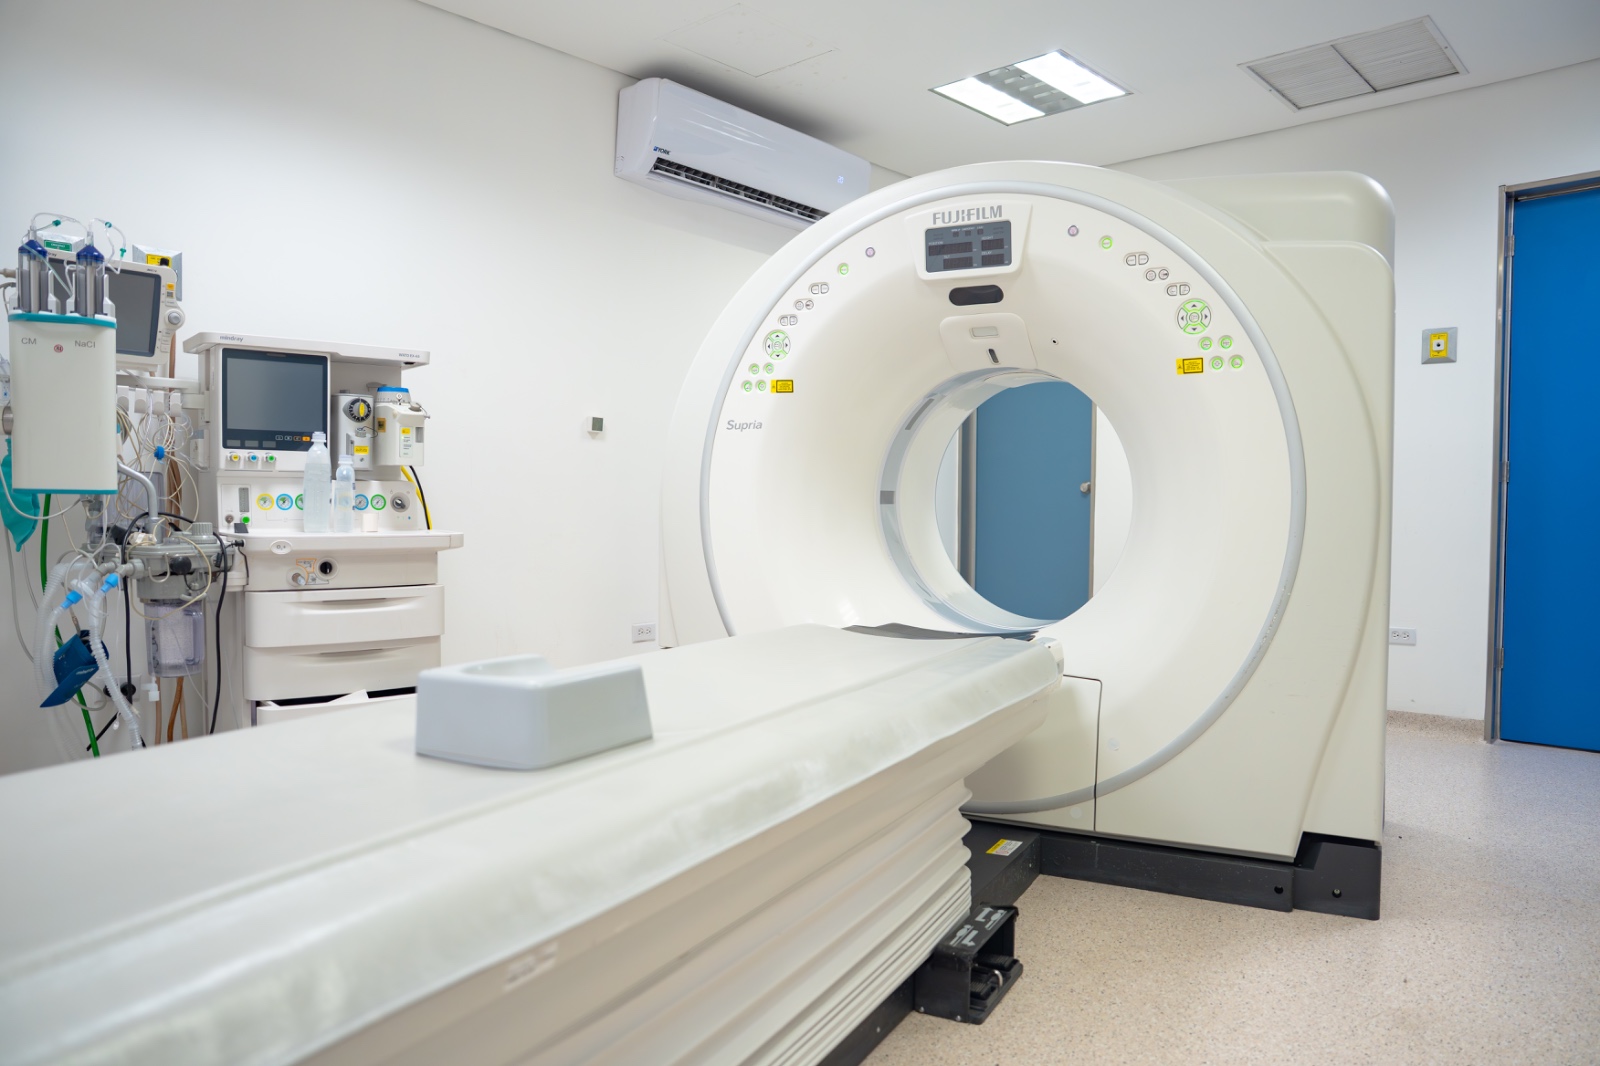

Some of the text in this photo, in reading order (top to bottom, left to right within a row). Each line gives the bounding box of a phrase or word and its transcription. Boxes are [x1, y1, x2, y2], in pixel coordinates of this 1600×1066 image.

[933, 205, 1002, 225] FUJIFILM
[21, 337, 96, 349] CM NaCl
[219, 335, 243, 343] mindray
[726, 419, 763, 432] Supria
